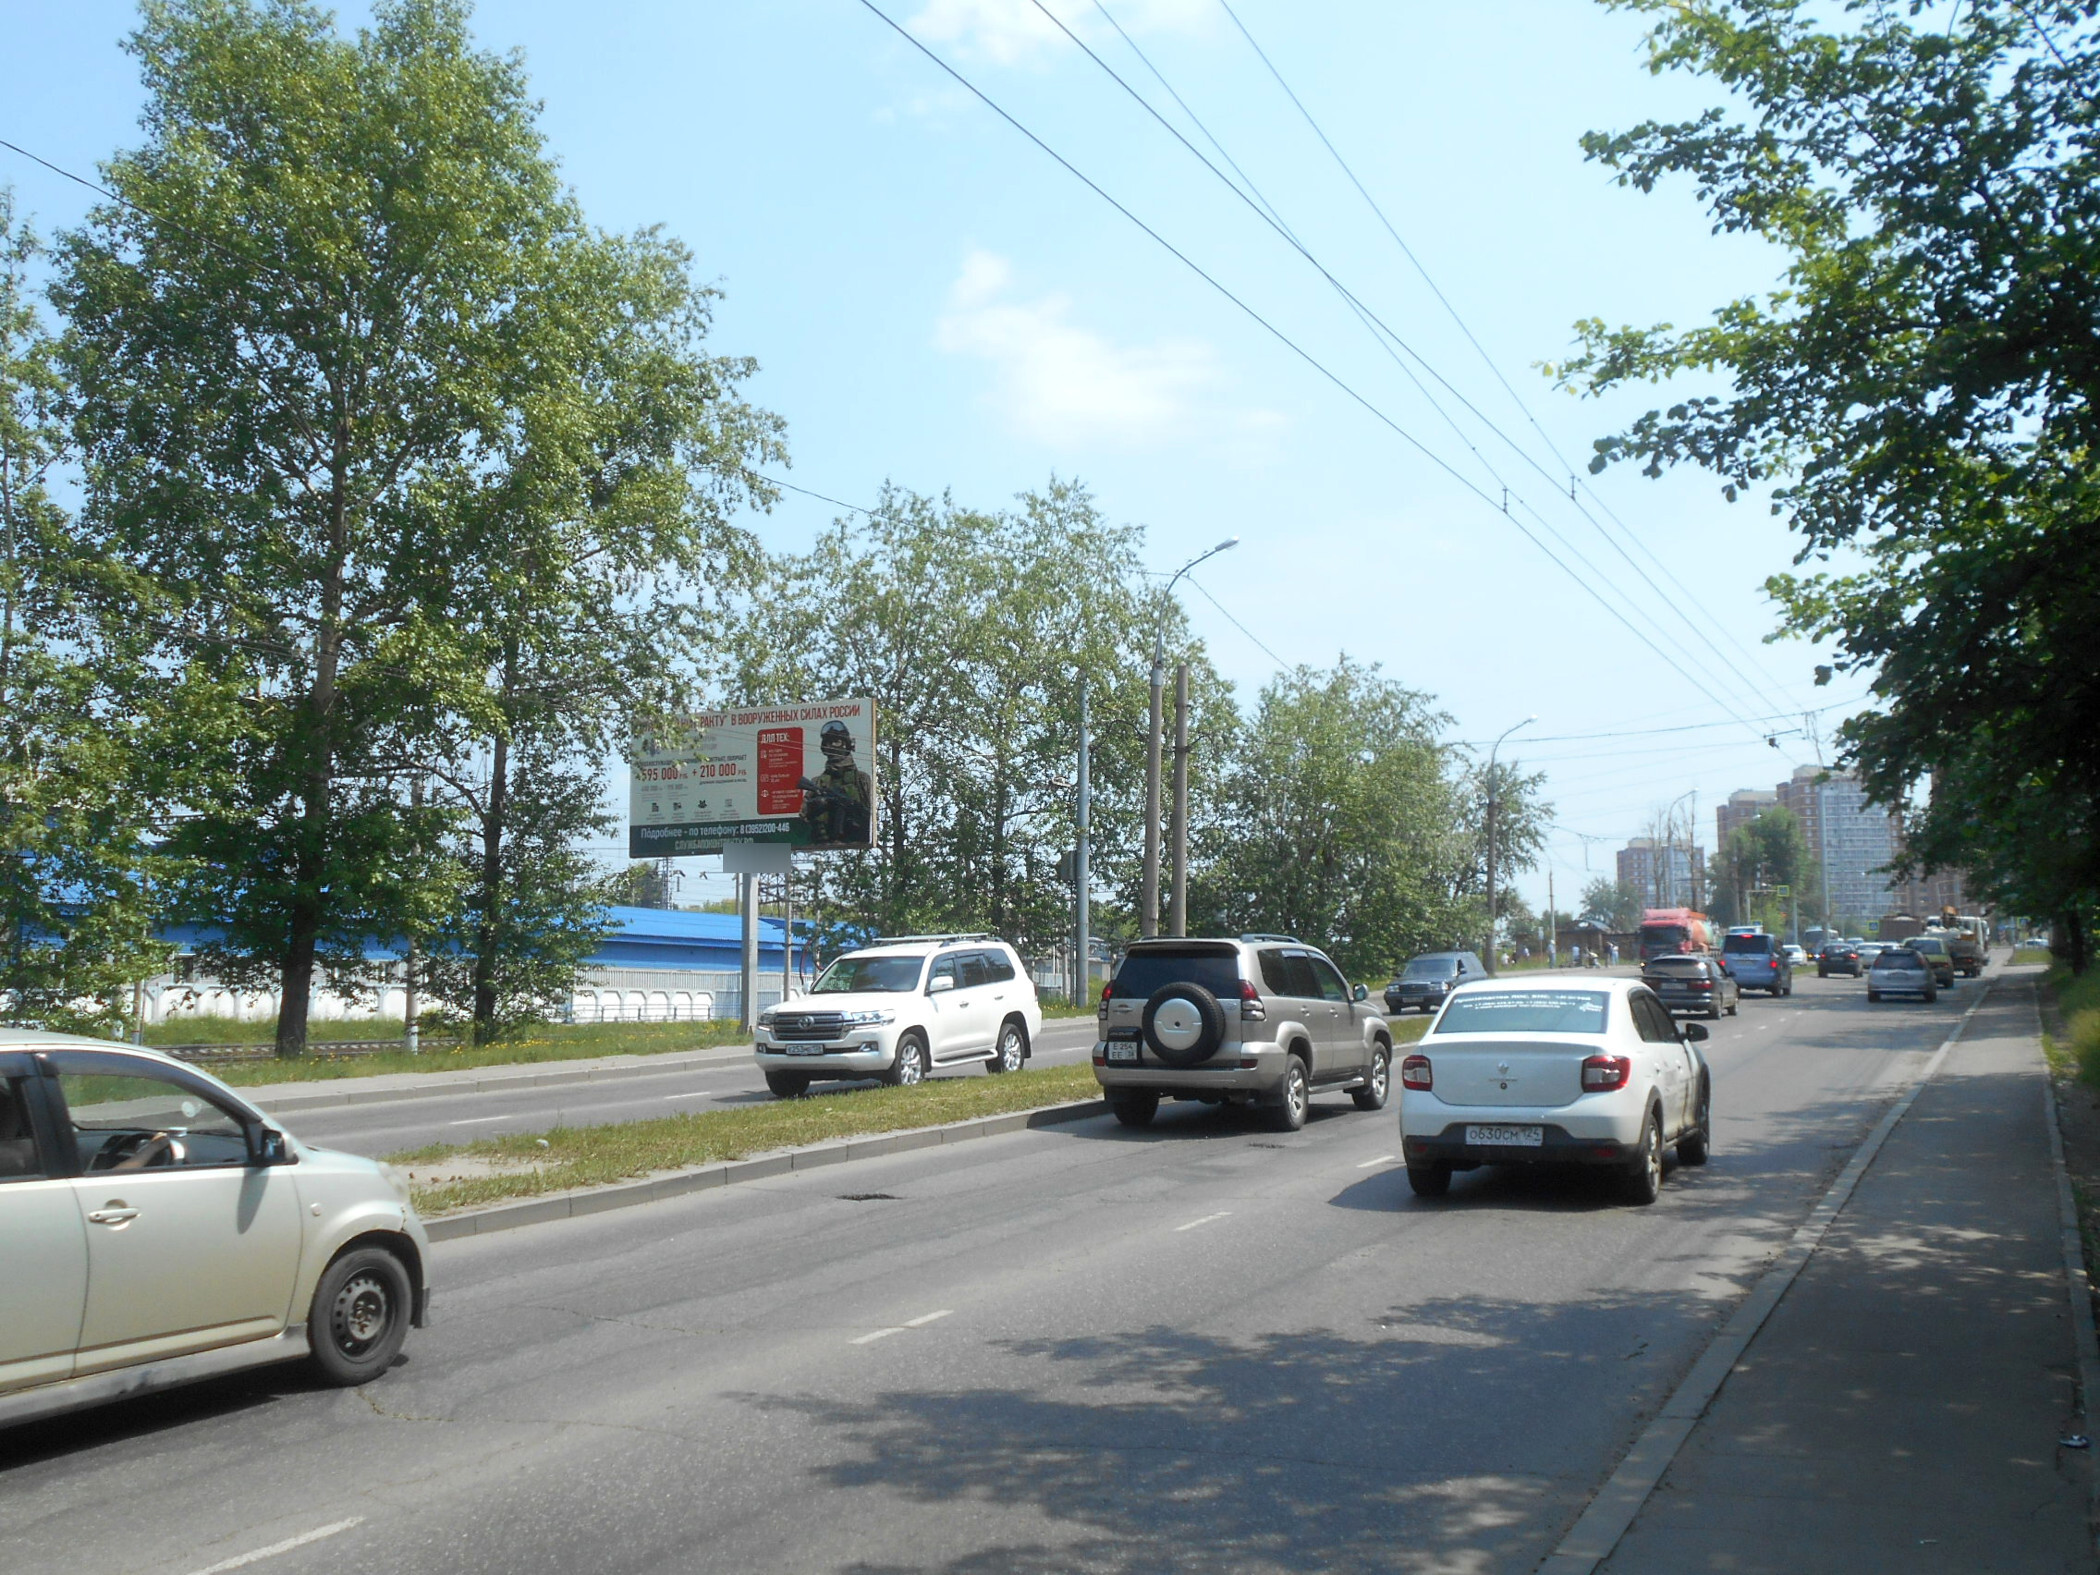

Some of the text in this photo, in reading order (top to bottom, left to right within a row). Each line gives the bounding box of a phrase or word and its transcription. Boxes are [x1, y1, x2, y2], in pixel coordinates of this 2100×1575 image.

[731, 714, 736, 726] В
[739, 709, 799, 726] ВООРУЖЕННЫХ
[801, 706, 827, 720] СИЛАХ
[830, 704, 860, 718] РОССИИ
[761, 733, 775, 744] ДЛЯ
[641, 768, 658, 781] 595
[661, 767, 678, 780] 000
[700, 764, 716, 778] 210
[718, 763, 736, 777] 000
[640, 827, 682, 840] Подробнее
[689, 826, 698, 836] по
[700, 823, 739, 838] телефону:
[740, 824, 745, 834] 8
[1113, 1042, 1118, 1050] Е
